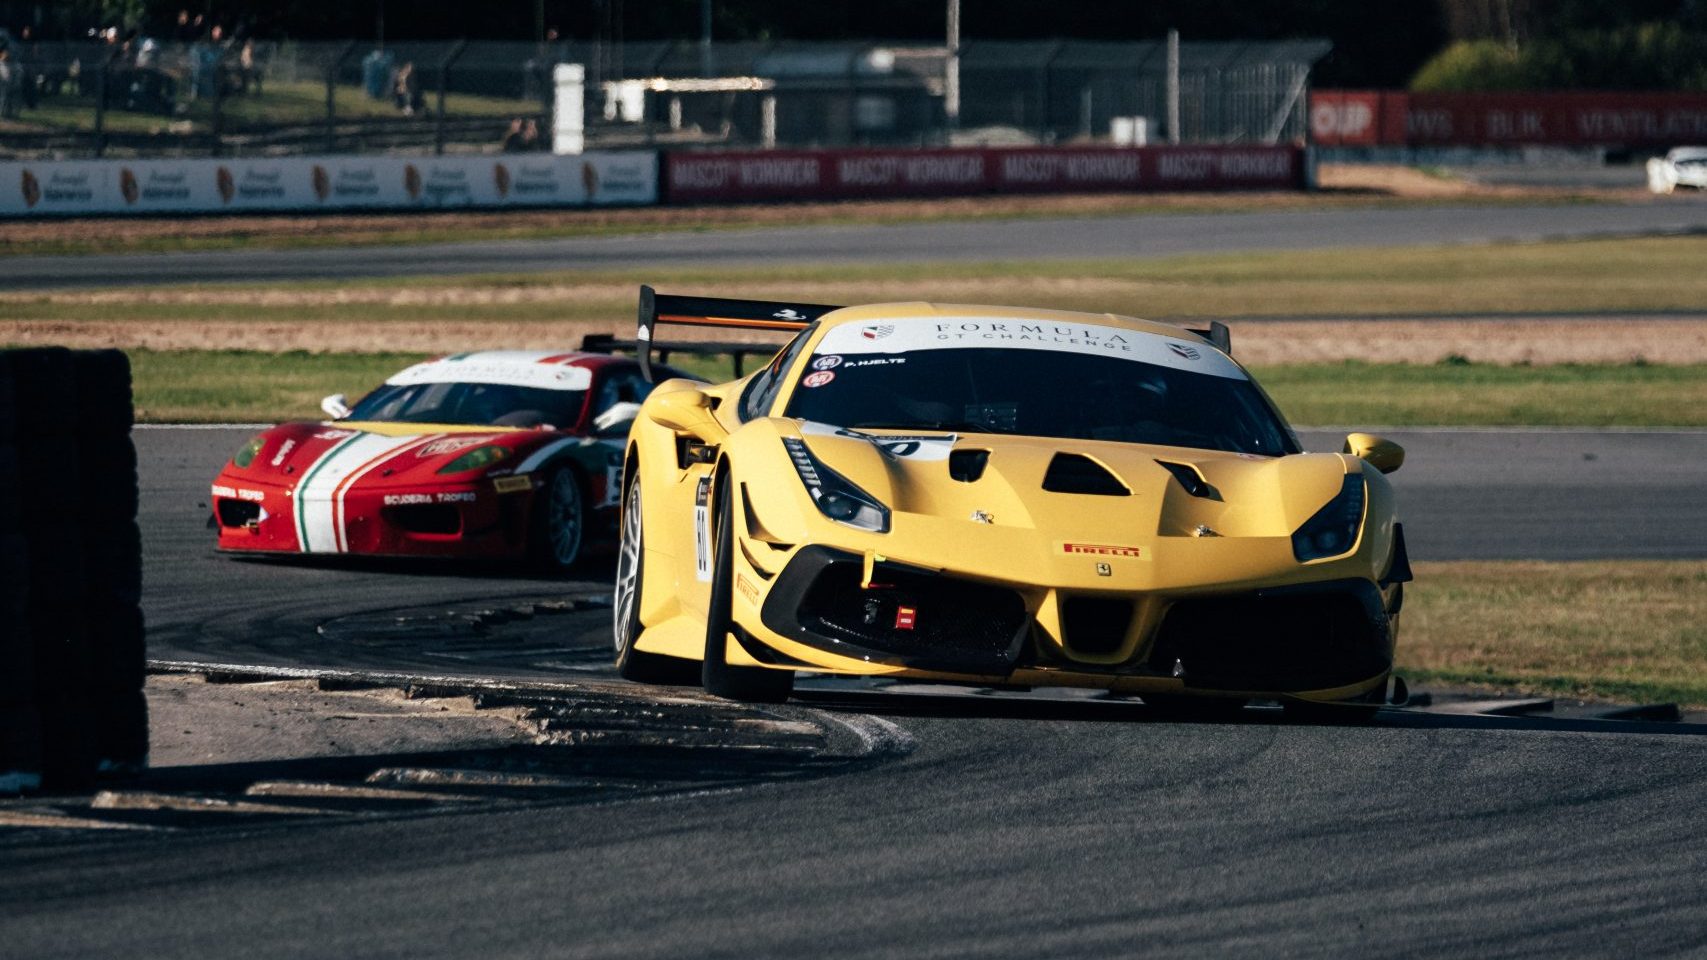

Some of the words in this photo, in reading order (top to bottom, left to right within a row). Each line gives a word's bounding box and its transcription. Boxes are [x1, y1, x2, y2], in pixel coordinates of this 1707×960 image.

[840, 159, 897, 184] MASCOT
[907, 157, 984, 182] WORKWEAR
[1005, 155, 1058, 180] MASCOT
[1067, 155, 1140, 180] WORKWEAR
[1159, 154, 1212, 178] MASCOT
[1220, 154, 1290, 178] WORKWEAR
[937, 324, 1128, 344] FORMULA
[982, 333, 1133, 352] CHALLENGE
[858, 357, 906, 367] HJELTE
[384, 494, 433, 505] SCUDERIA
[436, 491, 476, 503] TROFEO
[1063, 543, 1140, 558] PIRELLI
[736, 573, 760, 607] PIRELLI
